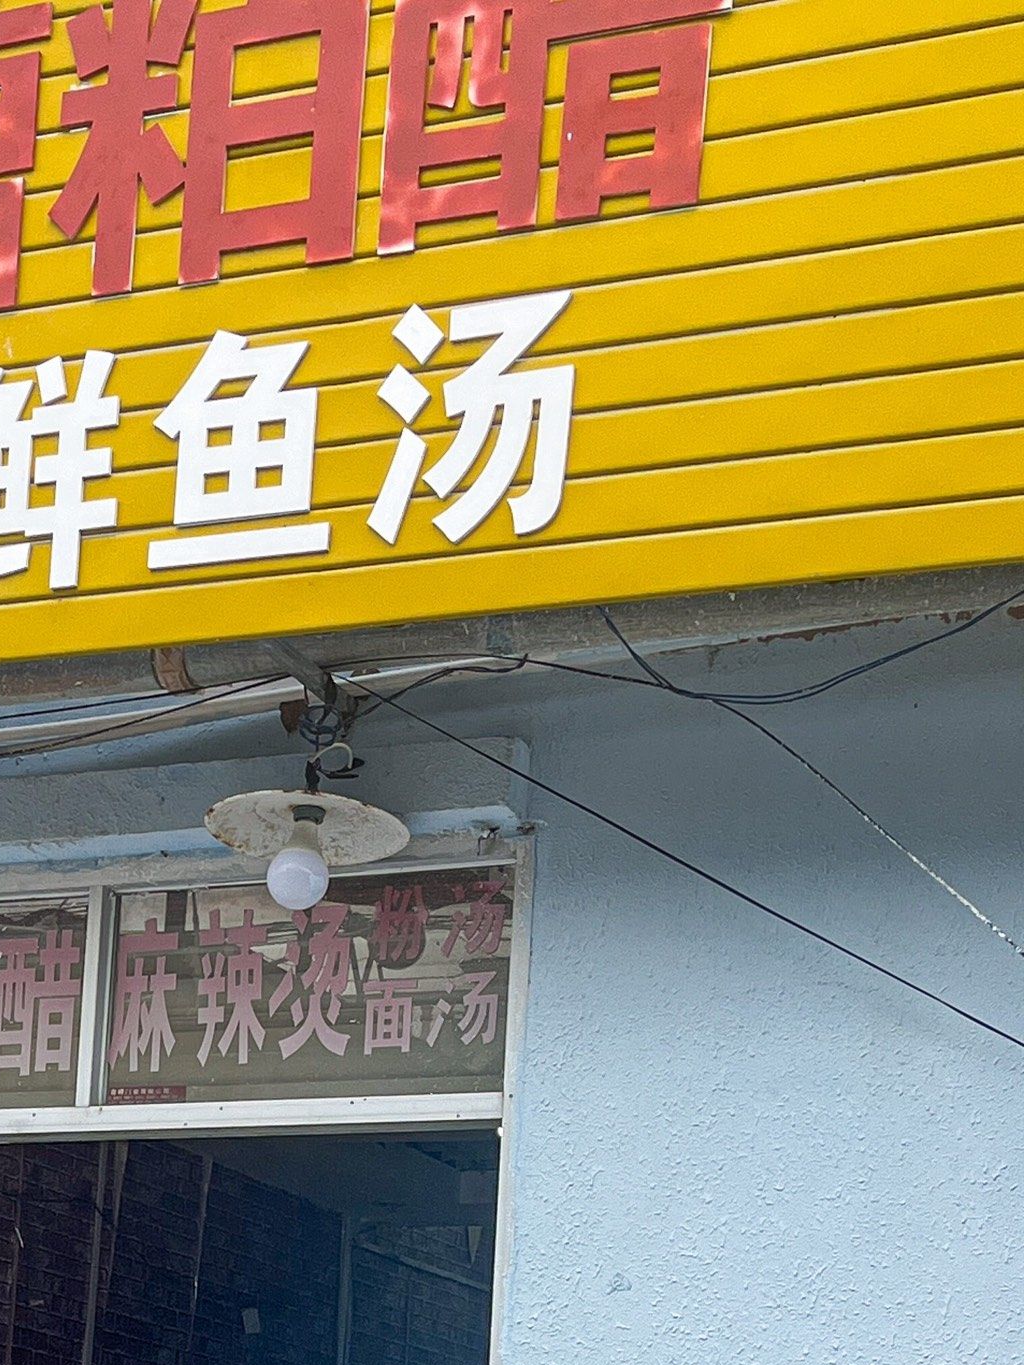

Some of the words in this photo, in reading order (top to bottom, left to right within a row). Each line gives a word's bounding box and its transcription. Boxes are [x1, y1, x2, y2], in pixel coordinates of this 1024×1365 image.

[372, 880, 507, 962] 粉汤
[106, 900, 350, 1073] 麻辣烫
[363, 971, 499, 1056] 面汤
